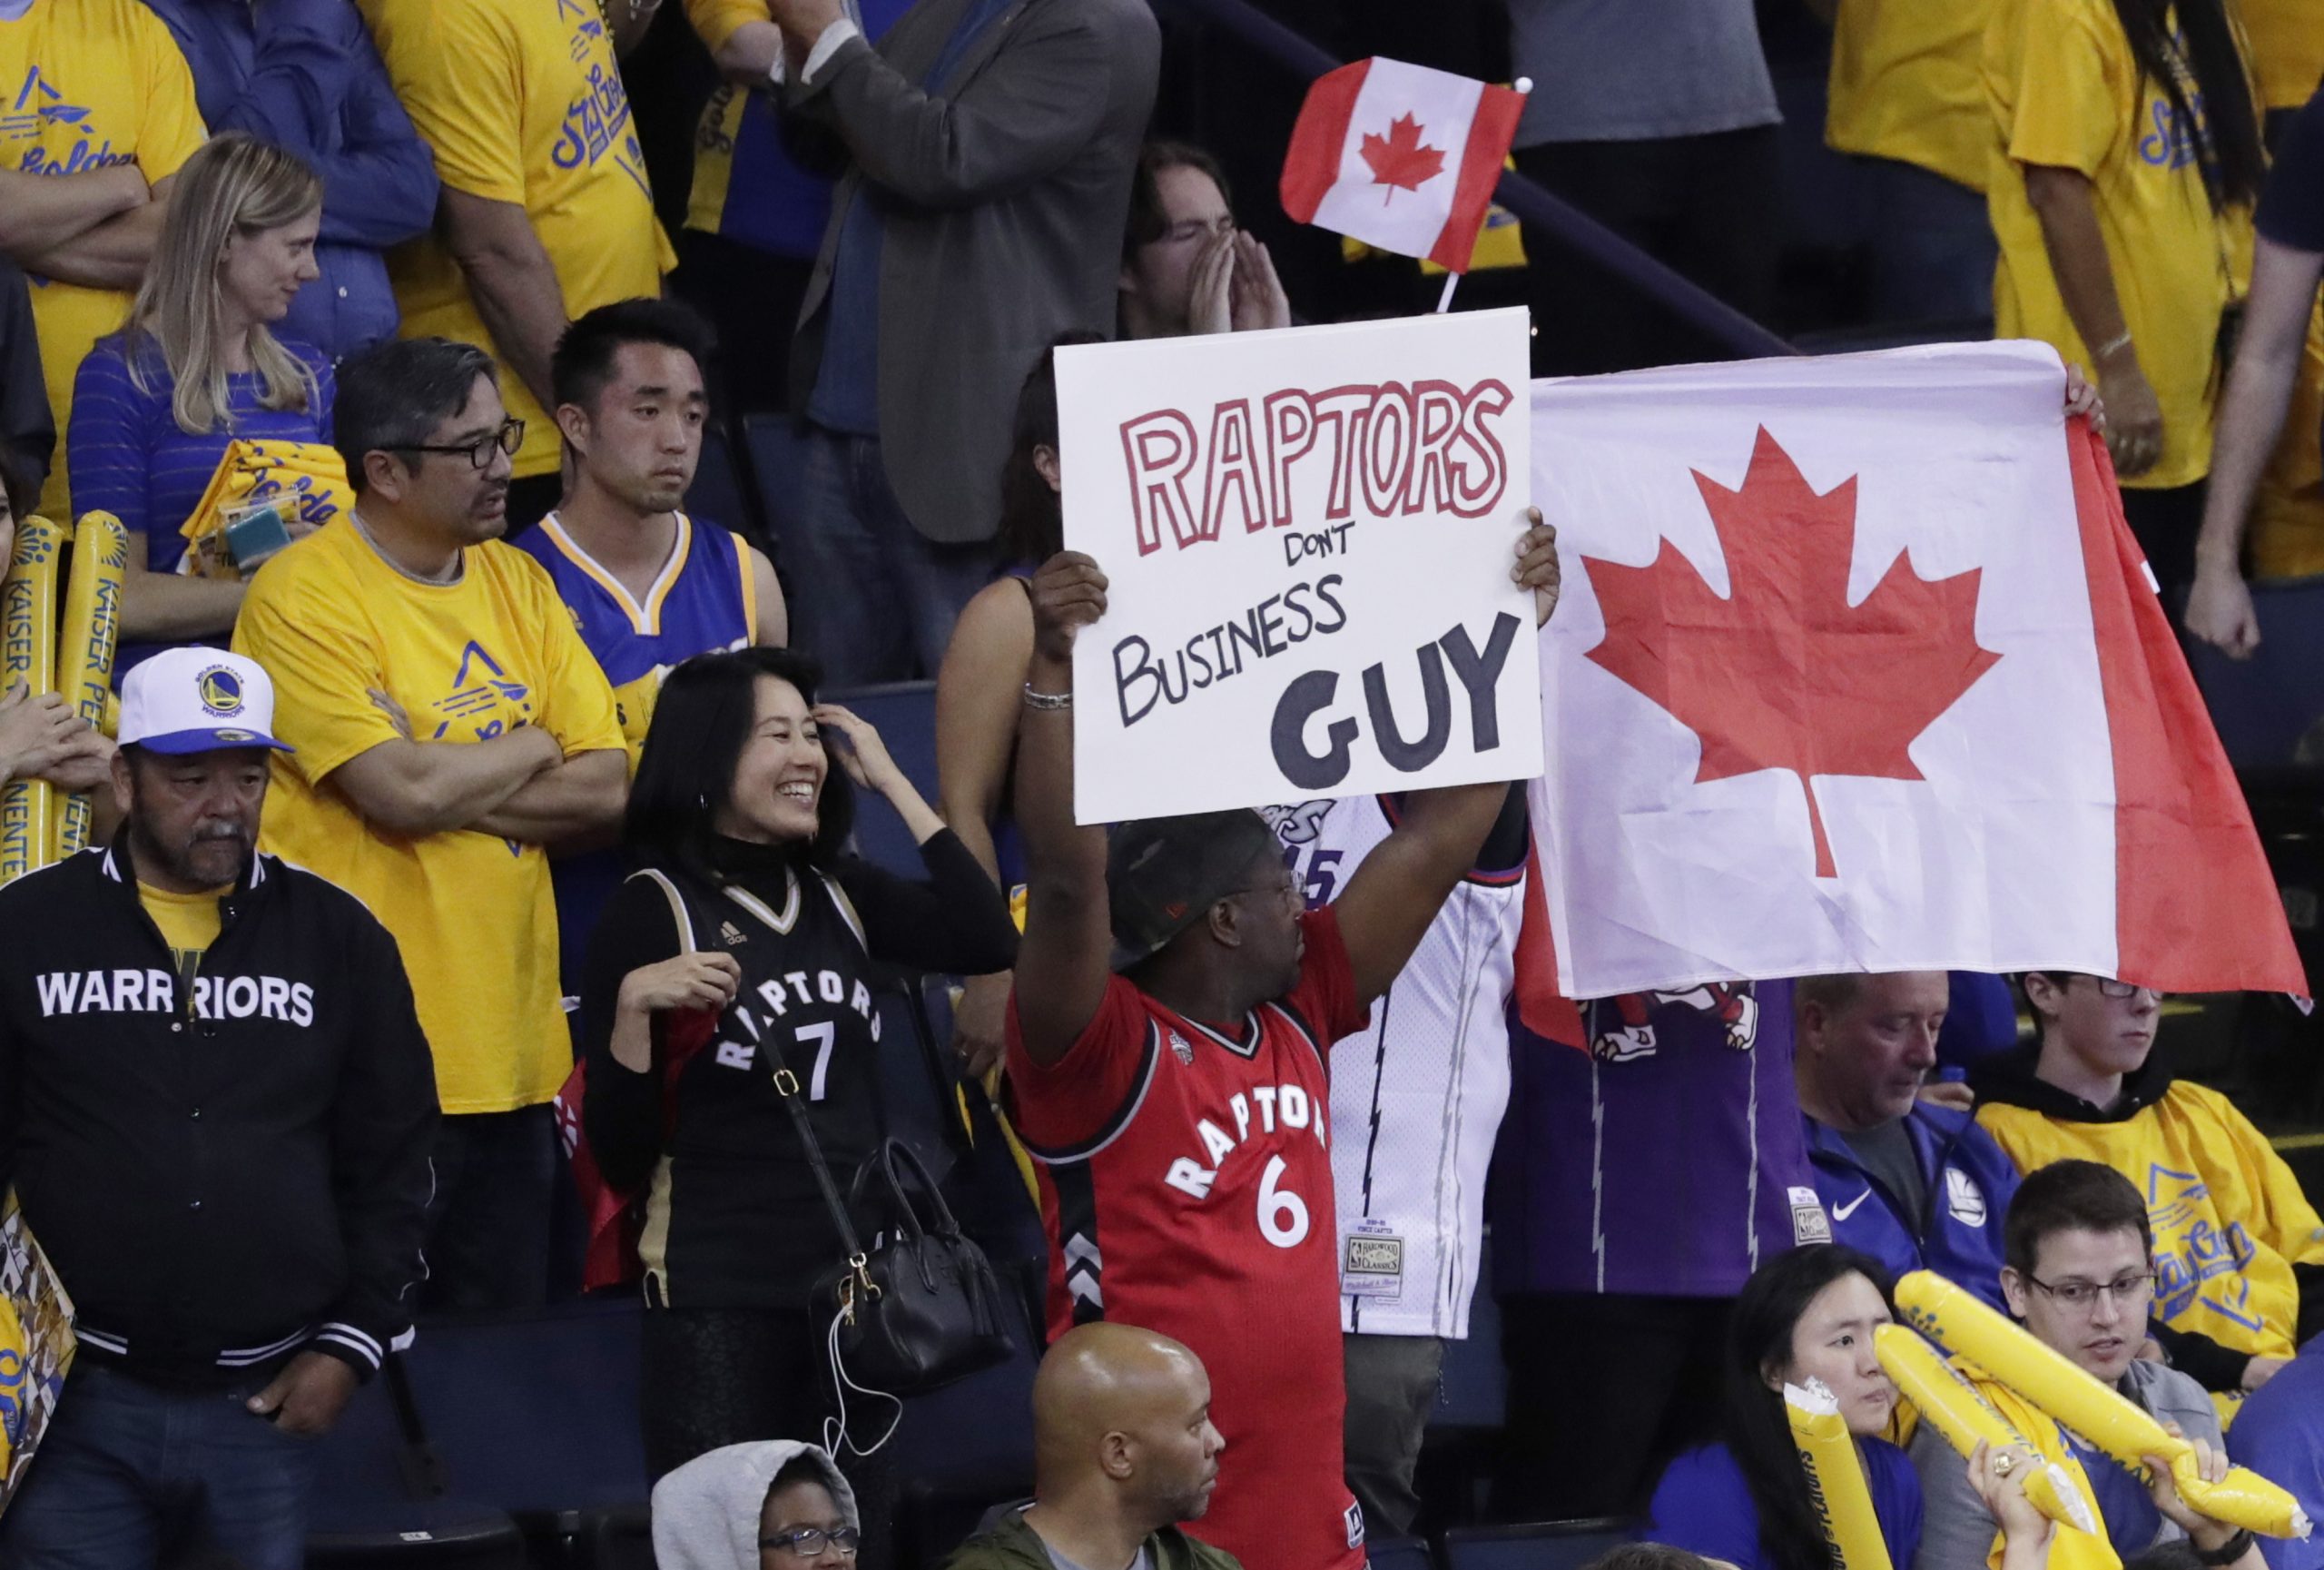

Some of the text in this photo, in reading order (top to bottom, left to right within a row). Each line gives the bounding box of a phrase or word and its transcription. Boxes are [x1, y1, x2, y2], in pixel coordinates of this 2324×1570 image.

[1119, 379, 1514, 557] RAPTORS
[1284, 520, 1355, 568] DON'T
[6, 578, 33, 674] KAISER
[86, 578, 120, 675] KAISER
[1112, 574, 1347, 728] BUSINESS
[202, 704, 246, 719] WARRIORS
[1271, 611, 1521, 790] GUY
[794, 1020, 835, 1101] 7
[1256, 1153, 1310, 1249] 6
[1363, 1241, 1399, 1257] HARDWOOD
[1362, 1257, 1398, 1270] CLASSICS
